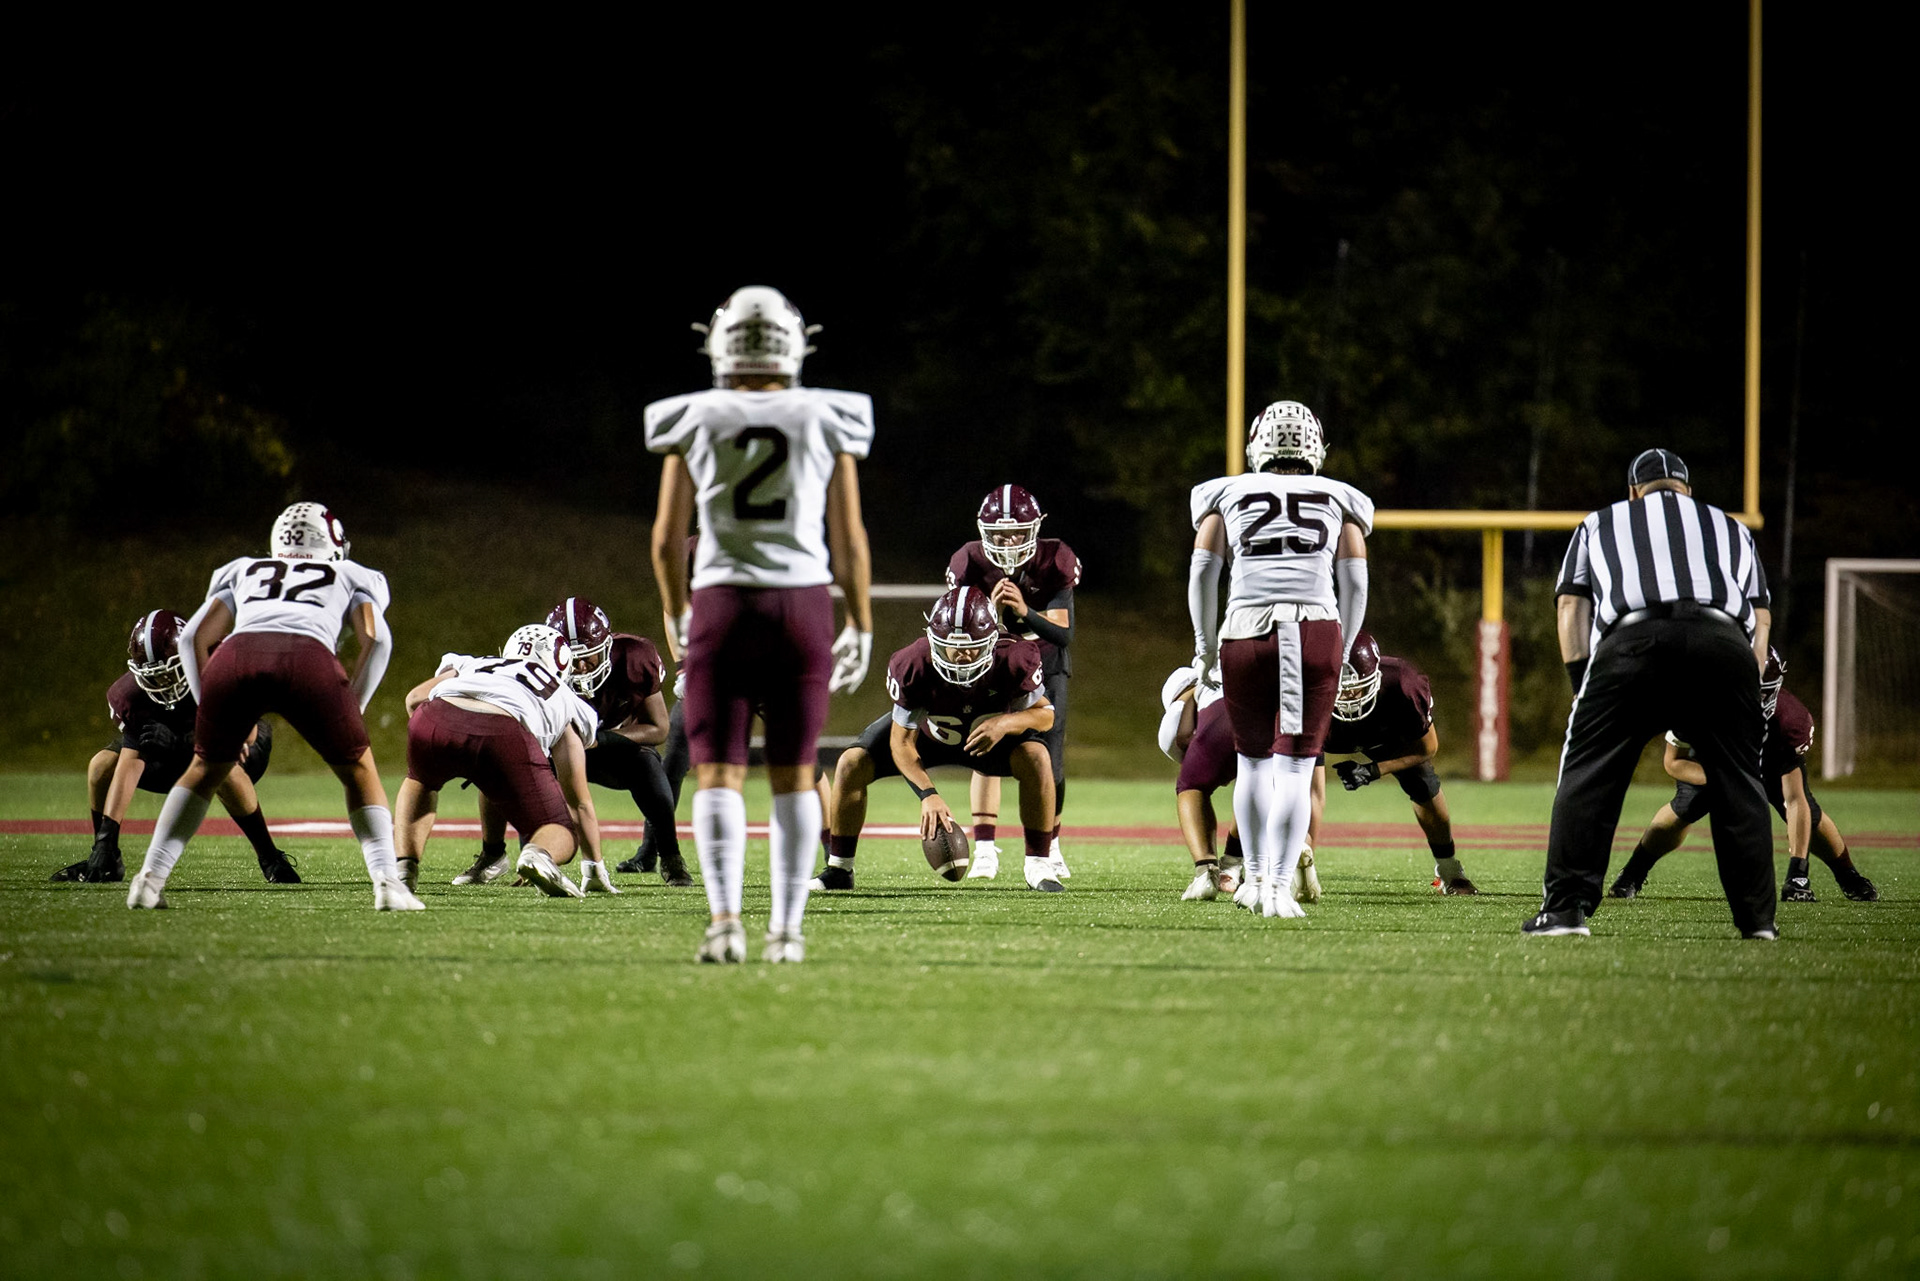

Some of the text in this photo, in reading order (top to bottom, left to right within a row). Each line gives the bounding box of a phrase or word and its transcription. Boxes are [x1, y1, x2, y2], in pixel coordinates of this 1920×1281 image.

[1277, 432, 1301, 447] 25
[734, 427, 788, 520] 2
[284, 530, 304, 546] 32
[1238, 492, 1330, 557] 25
[243, 560, 337, 609] 32
[517, 641, 532, 656] 79
